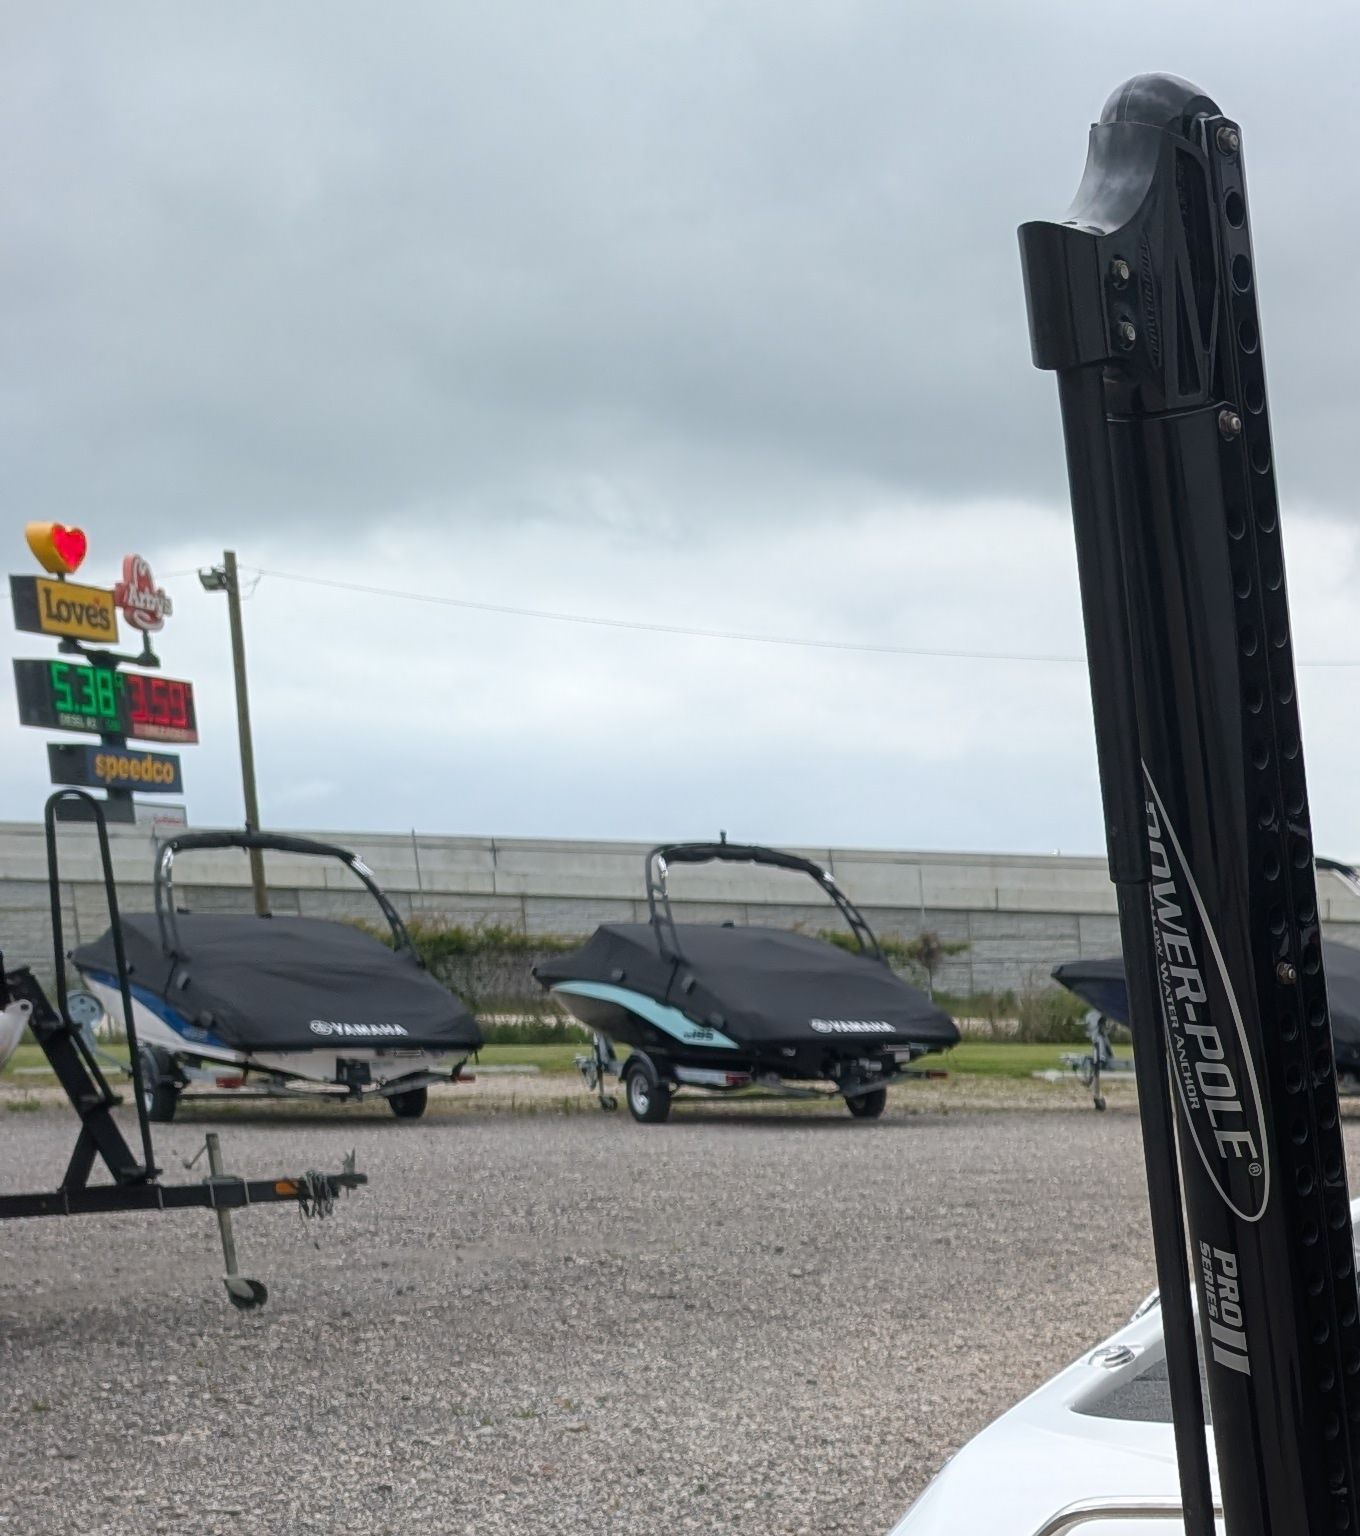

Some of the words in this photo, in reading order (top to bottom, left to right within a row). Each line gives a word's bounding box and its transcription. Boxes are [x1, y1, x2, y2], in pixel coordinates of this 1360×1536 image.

[95, 753, 175, 784] speedco
[330, 1021, 409, 1037] YAMAHA
[1160, 962, 1179, 1028] WATER
[1173, 1032, 1201, 1111] ANCHOR
[1199, 1239, 1219, 1320] SERIES
[1213, 1246, 1244, 1328] PRO
